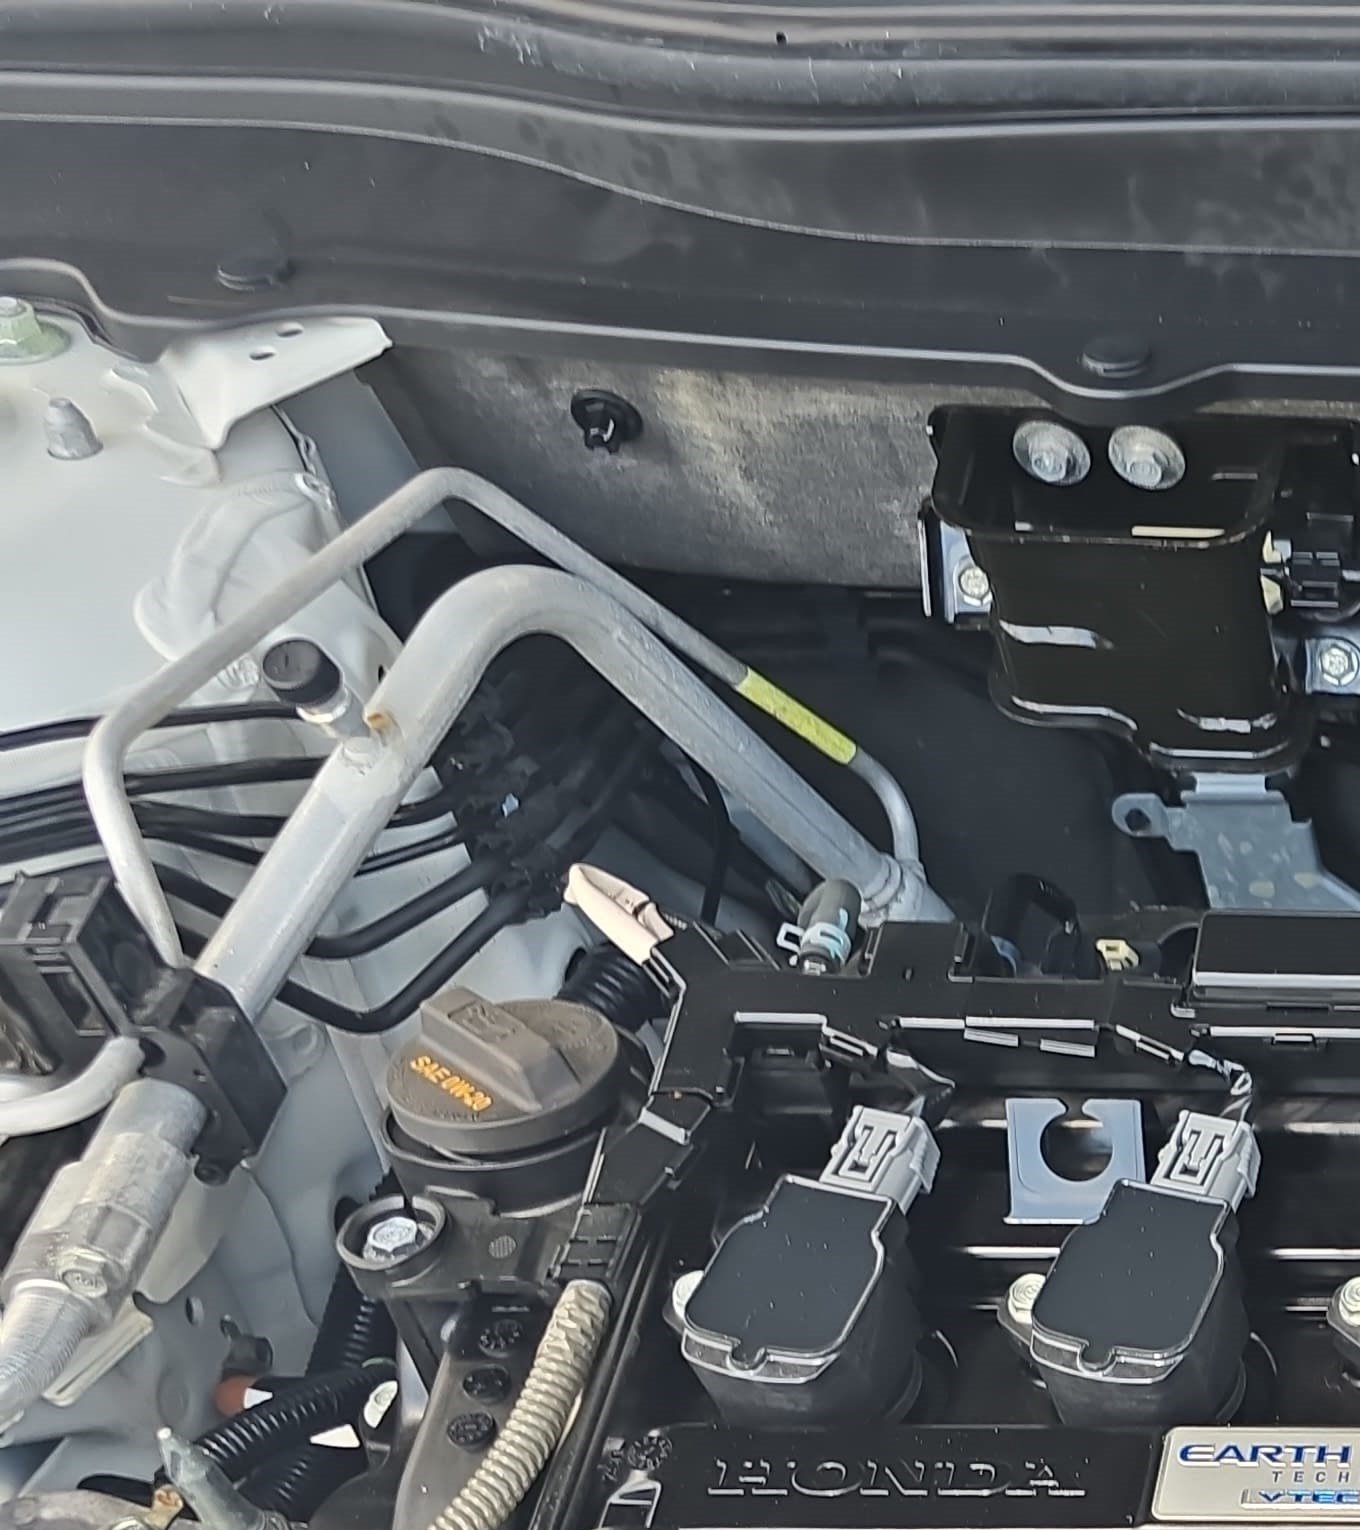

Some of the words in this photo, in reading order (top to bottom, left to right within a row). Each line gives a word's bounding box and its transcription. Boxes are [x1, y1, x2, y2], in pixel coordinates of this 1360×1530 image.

[410, 1055, 451, 1084] SAE
[441, 1076, 493, 1111] 0W-20
[1177, 1441, 1350, 1468] EARTH
[707, 1458, 1087, 1497] HONDA
[1258, 1489, 1360, 1504] VTEC
